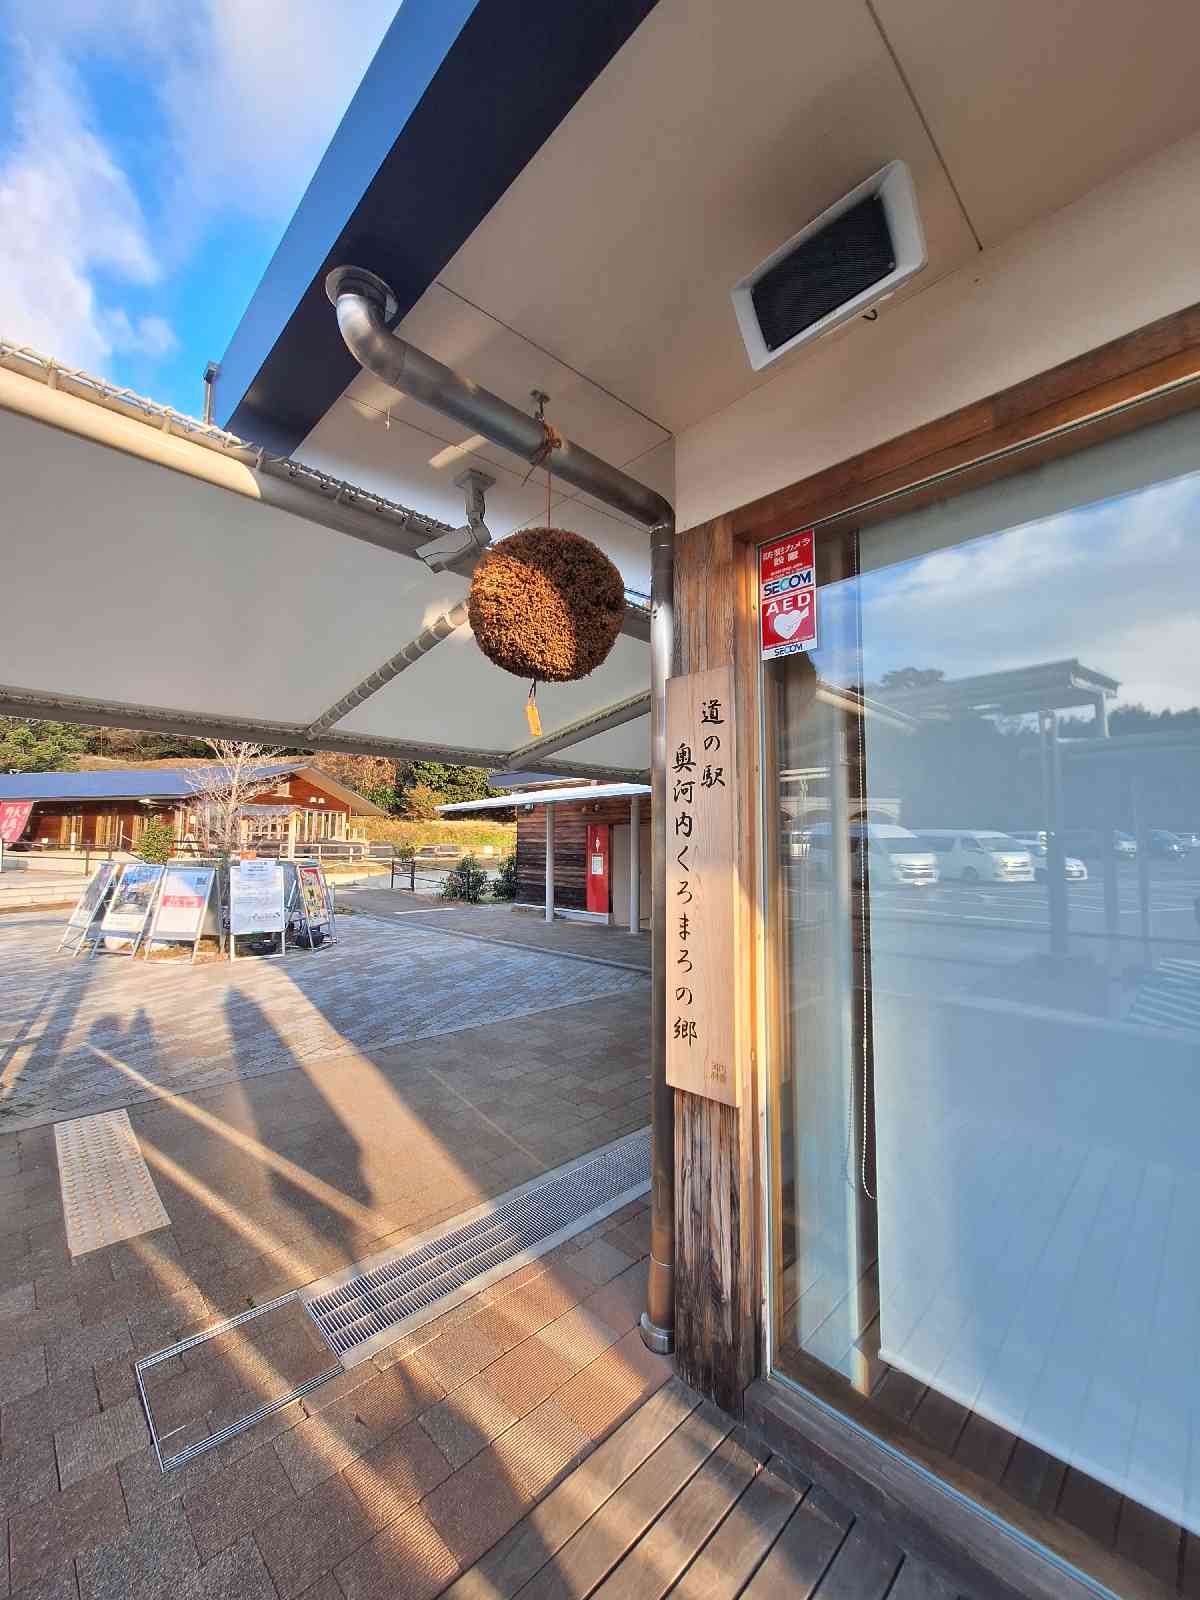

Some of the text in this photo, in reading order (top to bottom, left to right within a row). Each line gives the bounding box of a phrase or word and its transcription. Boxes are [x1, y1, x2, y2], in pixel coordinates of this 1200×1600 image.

[764, 570, 812, 597] SECOM
[766, 593, 811, 617] AED
[774, 643, 803, 656] SECOM
[700, 699, 726, 789] 道の駅
[672, 742, 698, 1047] 奥河内くろまろの郷
